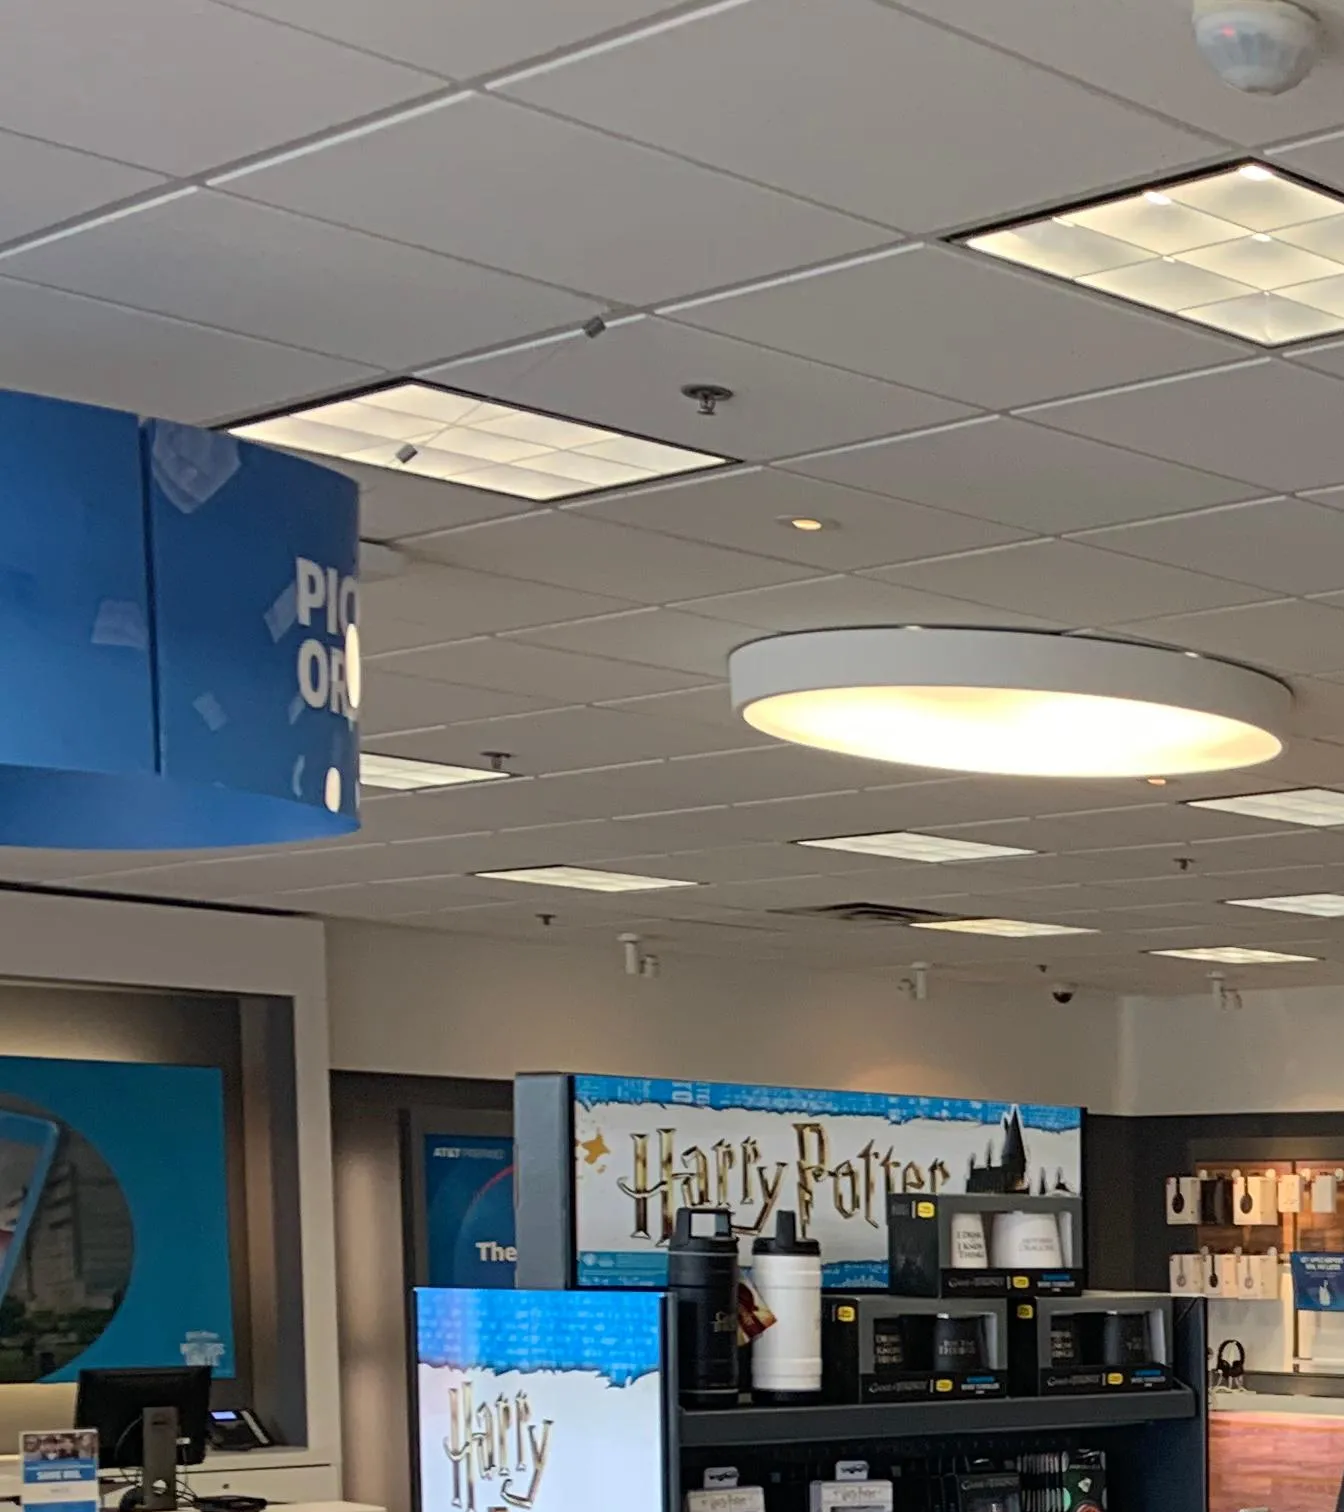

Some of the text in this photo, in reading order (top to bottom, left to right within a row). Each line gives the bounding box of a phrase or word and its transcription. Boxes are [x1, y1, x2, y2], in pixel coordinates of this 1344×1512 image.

[617, 1121, 952, 1248] Harry Potter
[475, 1240, 518, 1262] The
